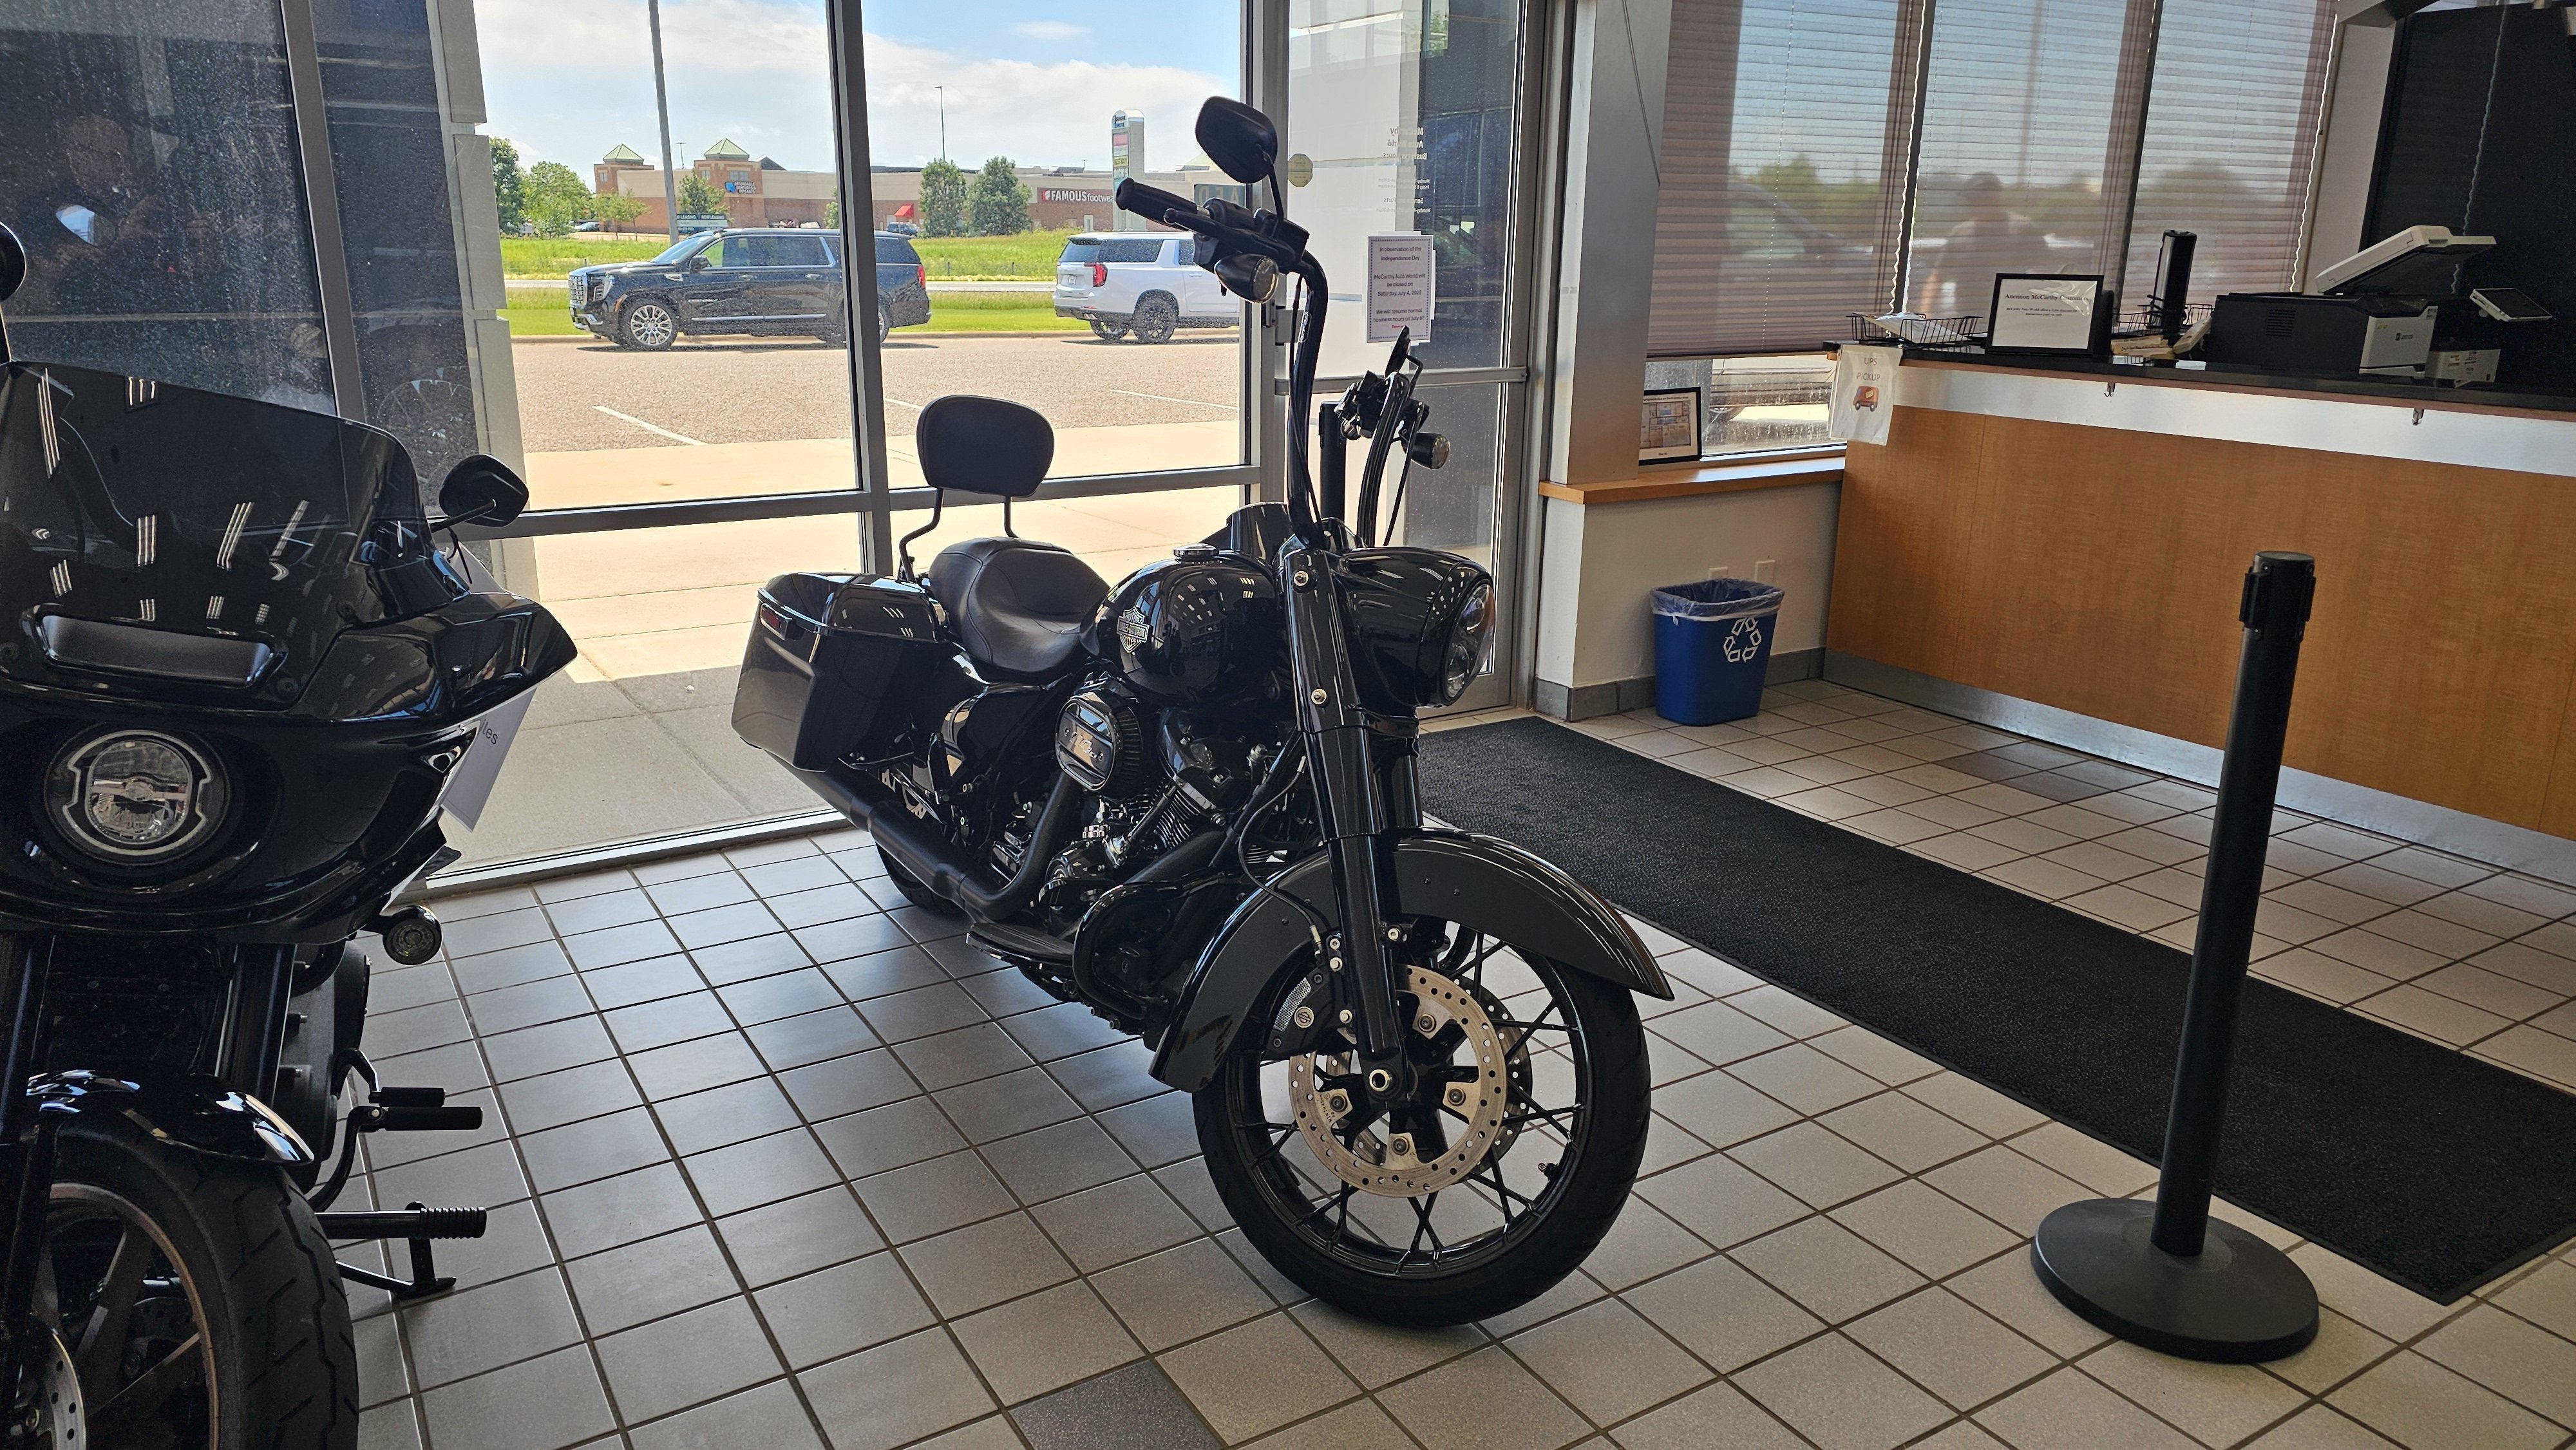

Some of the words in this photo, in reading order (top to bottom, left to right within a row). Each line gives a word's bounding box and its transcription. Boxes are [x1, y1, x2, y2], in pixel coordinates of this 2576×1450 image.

[1051, 190, 1087, 202] FAMOUS
[1087, 193, 1114, 202] footwea
[1857, 372, 1880, 381] PICKUP
[481, 719, 498, 745] iles
